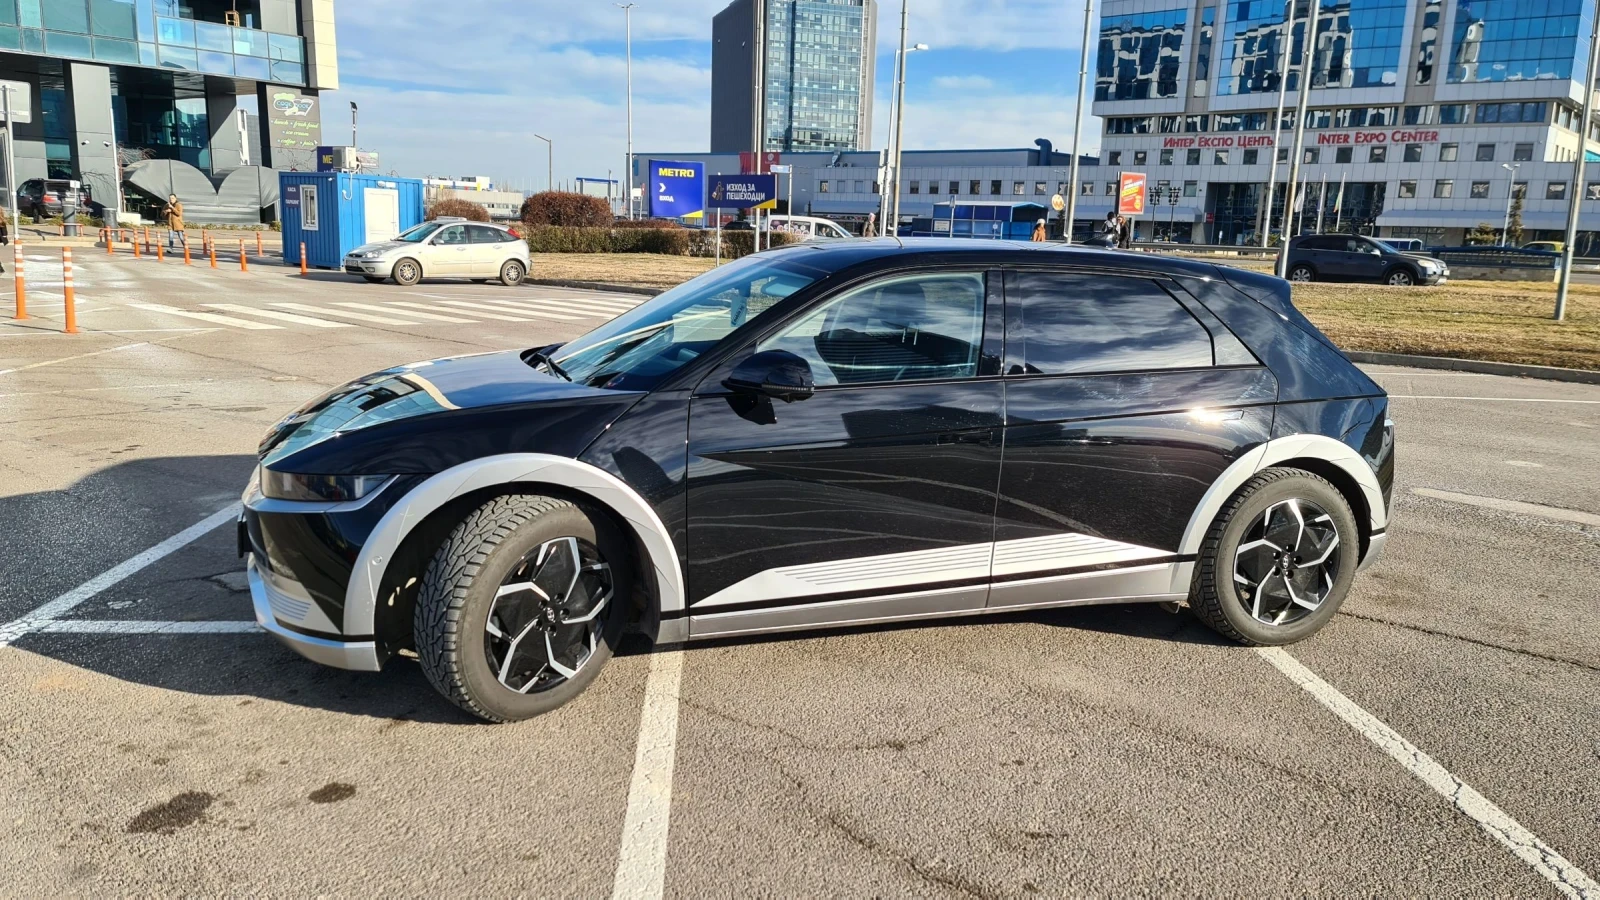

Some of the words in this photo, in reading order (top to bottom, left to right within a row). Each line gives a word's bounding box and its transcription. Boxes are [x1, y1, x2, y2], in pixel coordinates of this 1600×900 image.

[1237, 135, 1274, 148] ЦЕНТЪ
[1317, 133, 1350, 144] INTER
[1354, 131, 1387, 143] EXPO
[1391, 130, 1439, 142] CENTER
[658, 168, 695, 178] METRO
[726, 183, 748, 193] ИЗХОД
[747, 183, 756, 192] ЗА
[659, 195, 675, 203] ВХОД
[726, 192, 766, 202] ПЕШЕХОДЦИ
